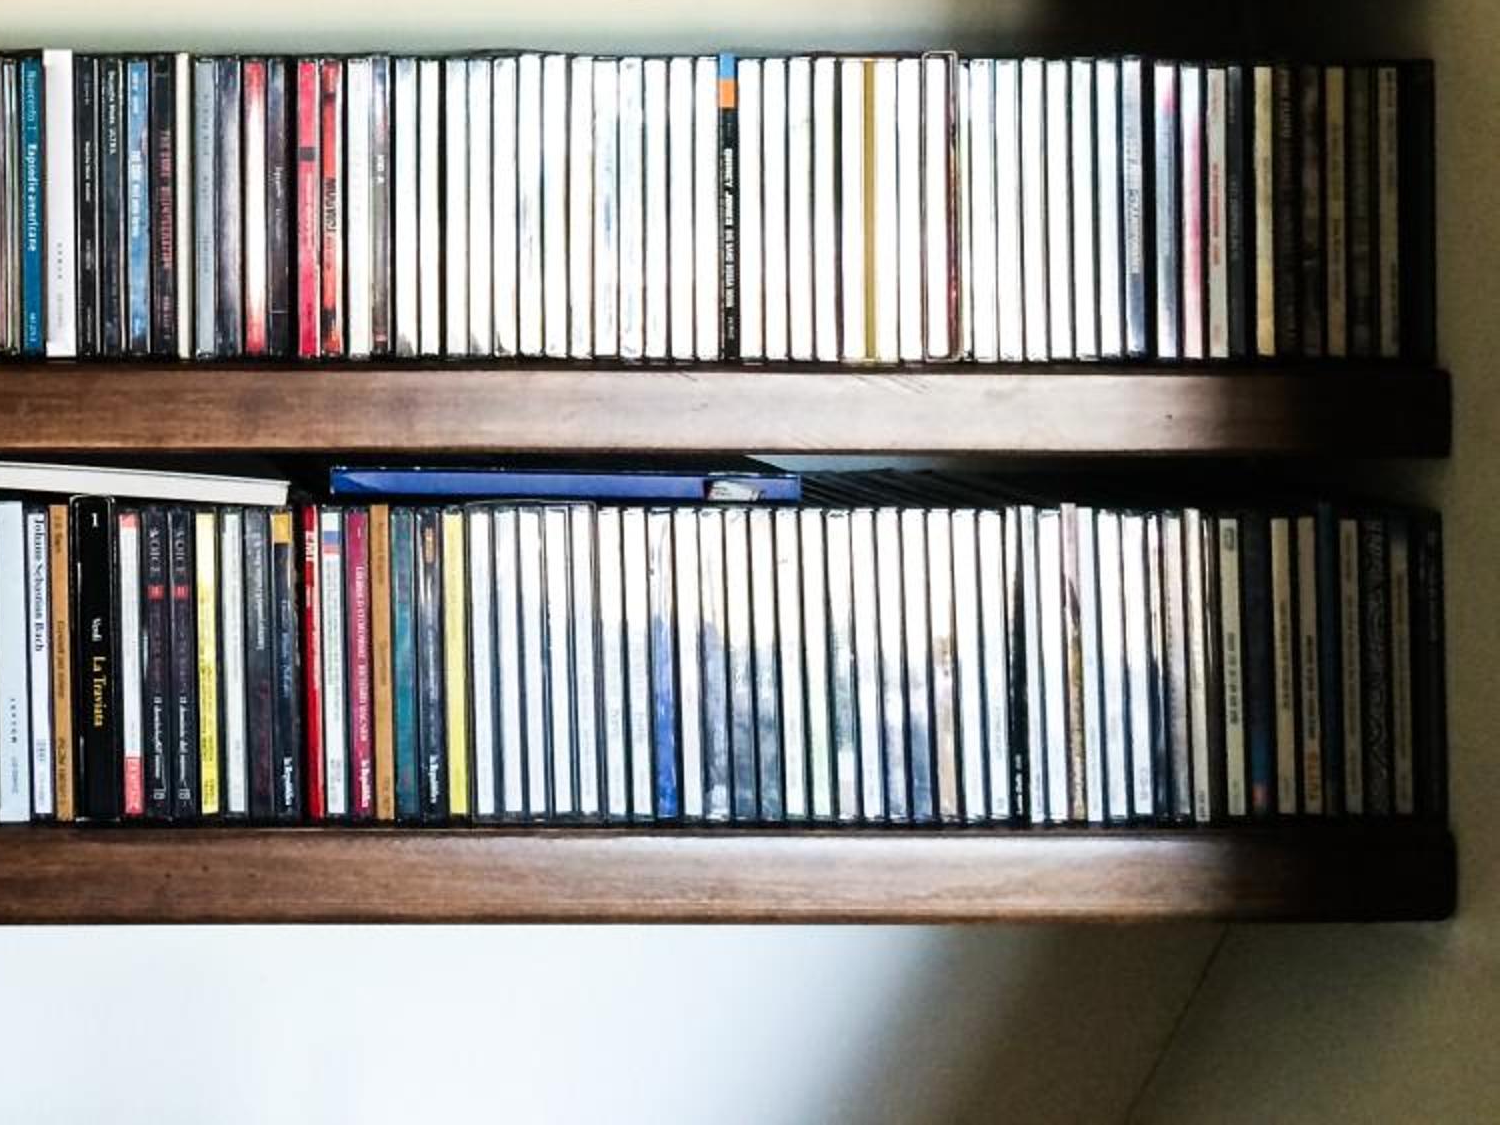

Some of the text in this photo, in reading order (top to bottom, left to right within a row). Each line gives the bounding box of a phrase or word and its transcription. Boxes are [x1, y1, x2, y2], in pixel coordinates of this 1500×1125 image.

[27, 144, 38, 193] Rapsodie
[28, 195, 38, 251] americane
[33, 517, 44, 652] Johann Sebastian Bach
[92, 657, 104, 671] La
[92, 674, 106, 727] Traviata
